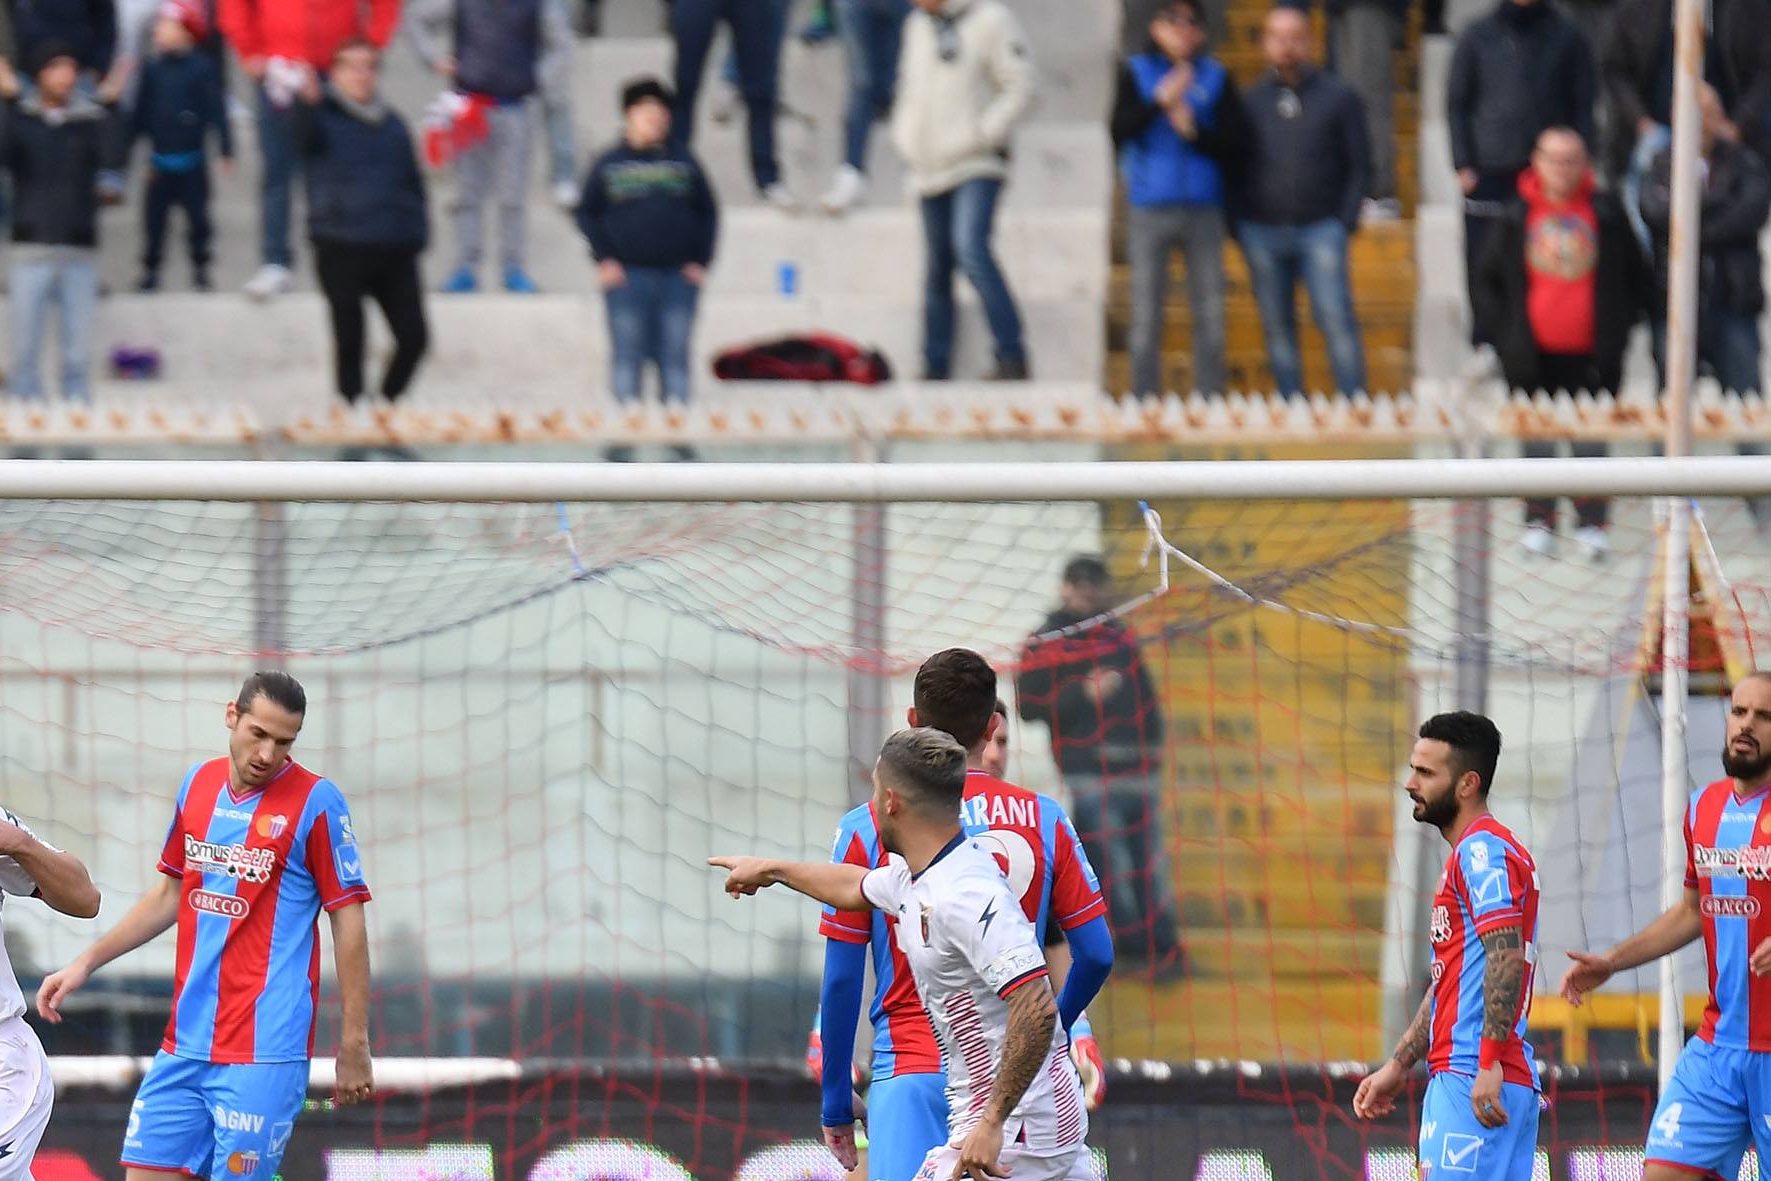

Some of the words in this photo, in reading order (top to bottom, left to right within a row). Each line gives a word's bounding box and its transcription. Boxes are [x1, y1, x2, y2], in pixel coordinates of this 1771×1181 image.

[961, 793, 1037, 828] ARANI
[202, 893, 243, 914] BACCO
[228, 1110, 265, 1134] GNV
[1656, 1102, 1683, 1139] 4
